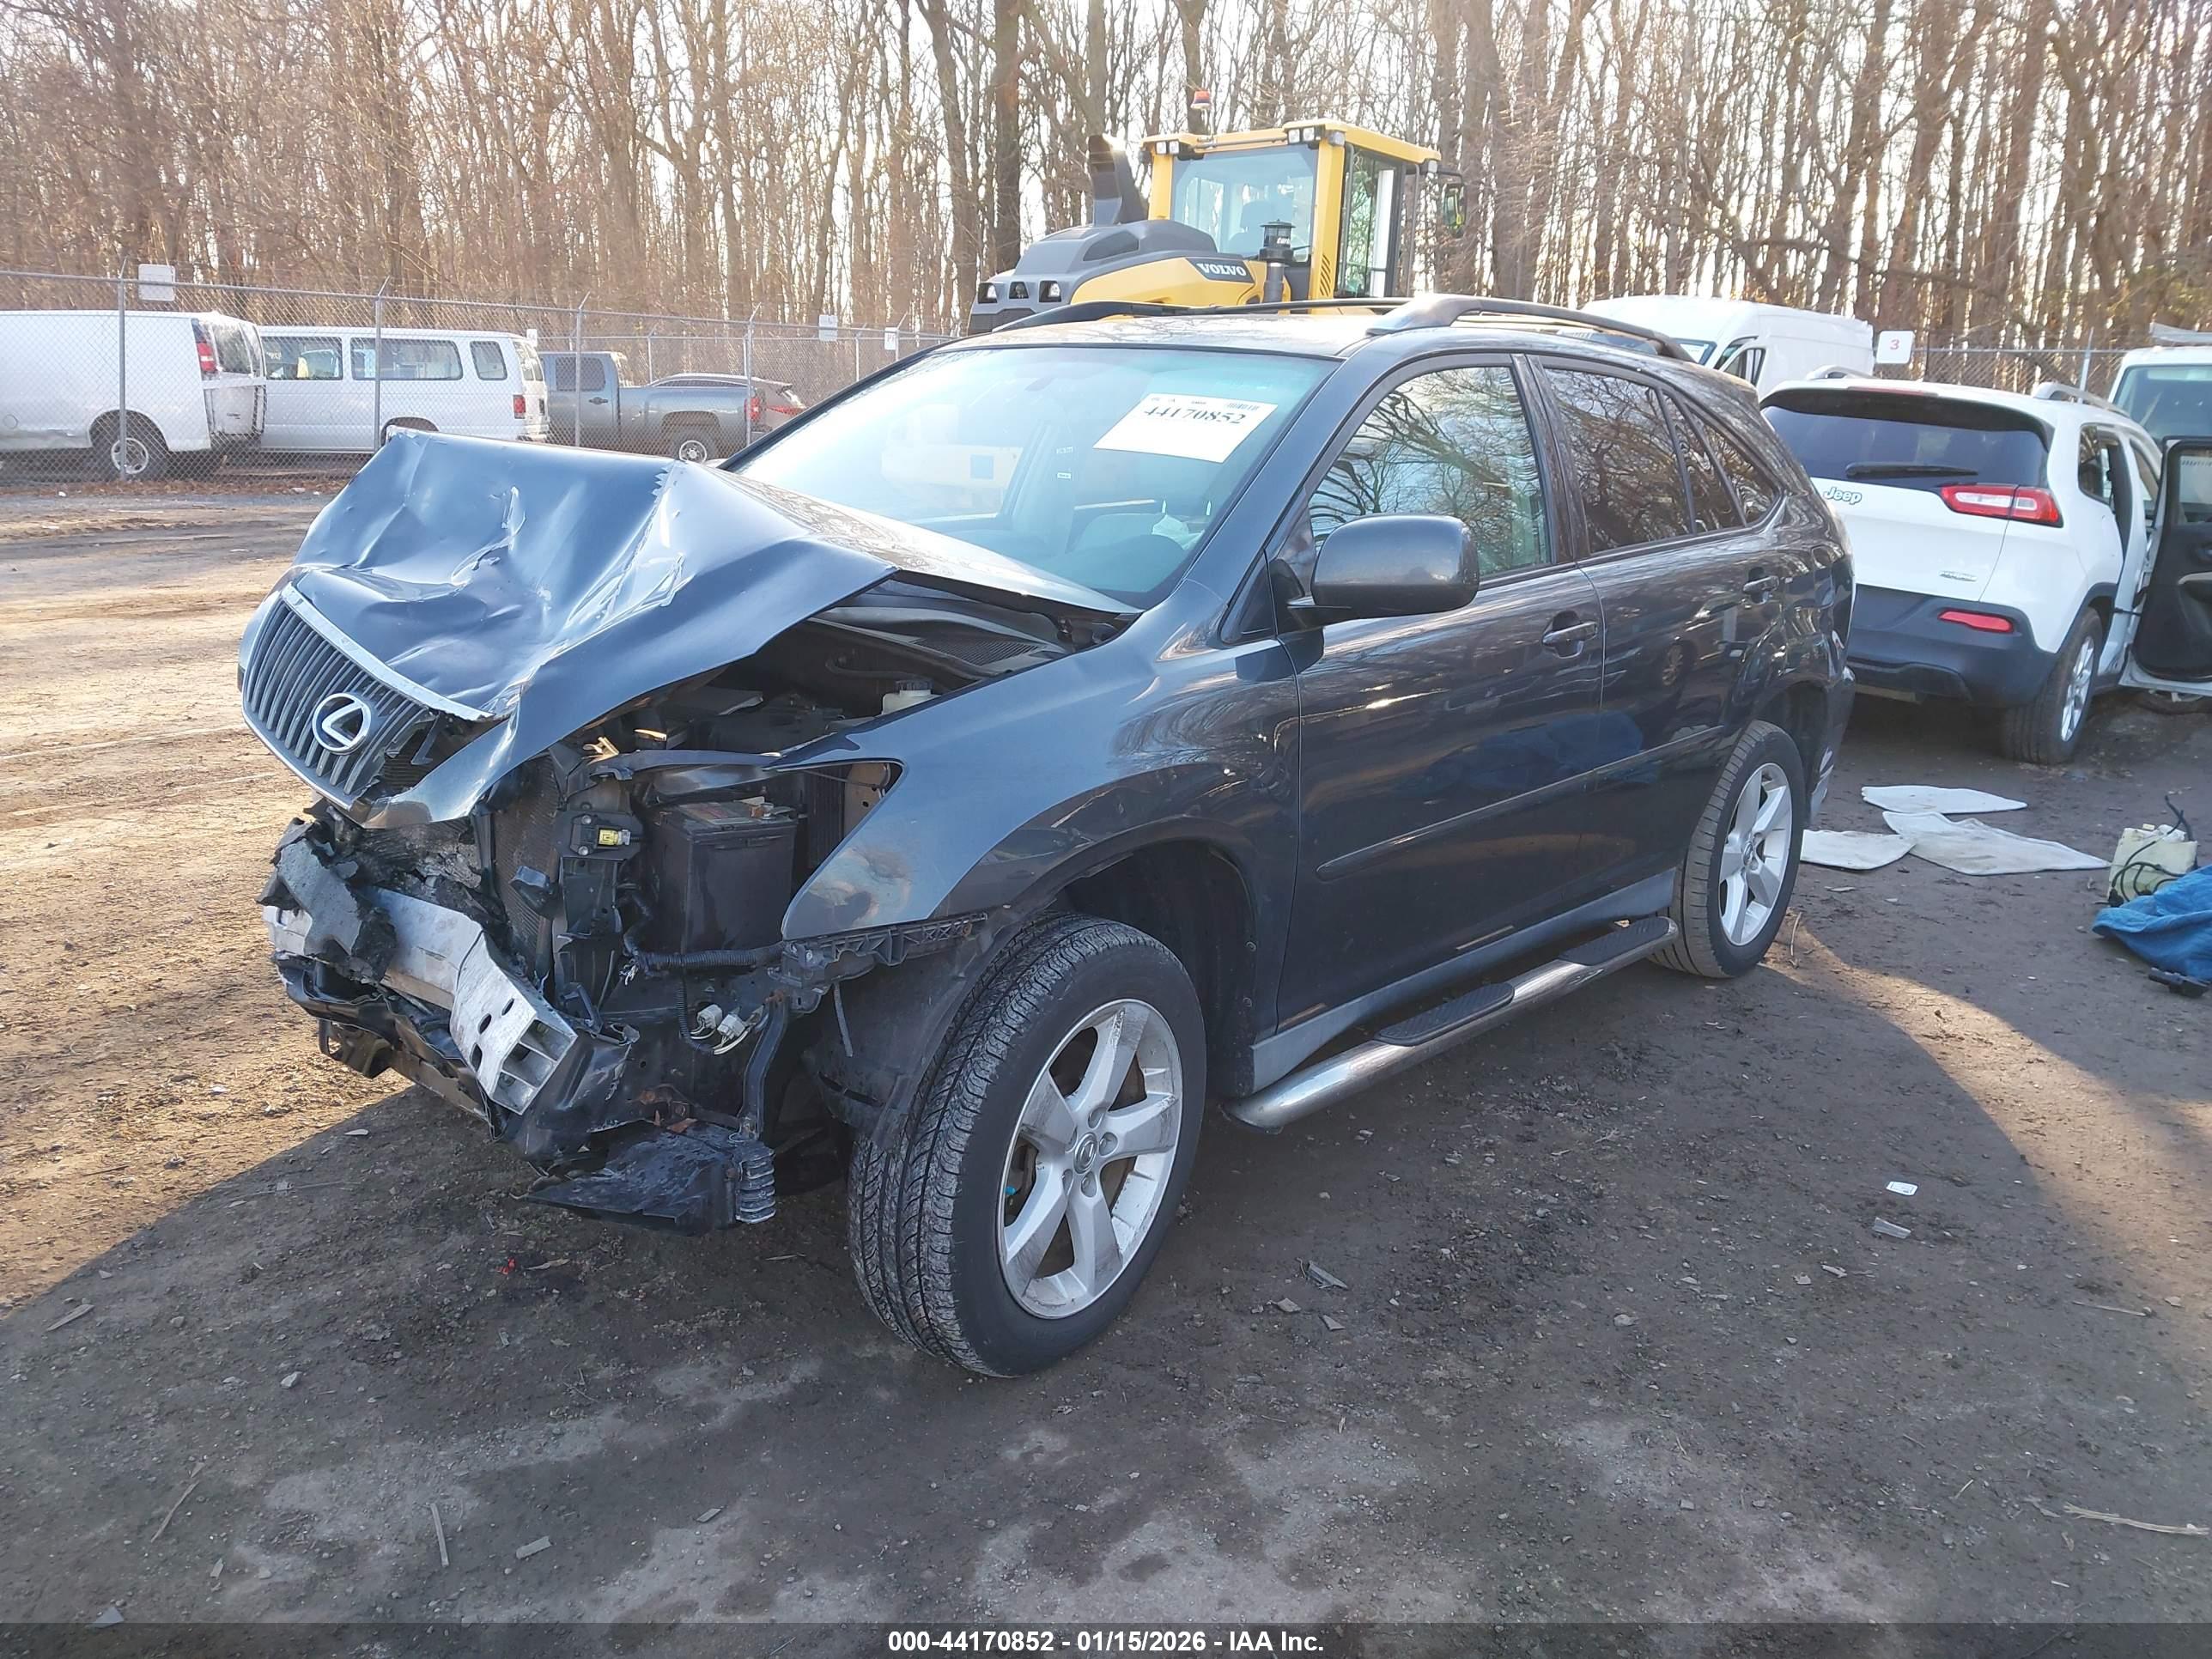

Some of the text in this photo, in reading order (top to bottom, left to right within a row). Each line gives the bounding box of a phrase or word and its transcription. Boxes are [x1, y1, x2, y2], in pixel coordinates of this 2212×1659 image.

[1196, 263, 1247, 276] VOLVO
[1890, 339, 1899, 350] 3
[1144, 406, 1246, 424] 44170852
[1822, 486, 1863, 505] Jeep
